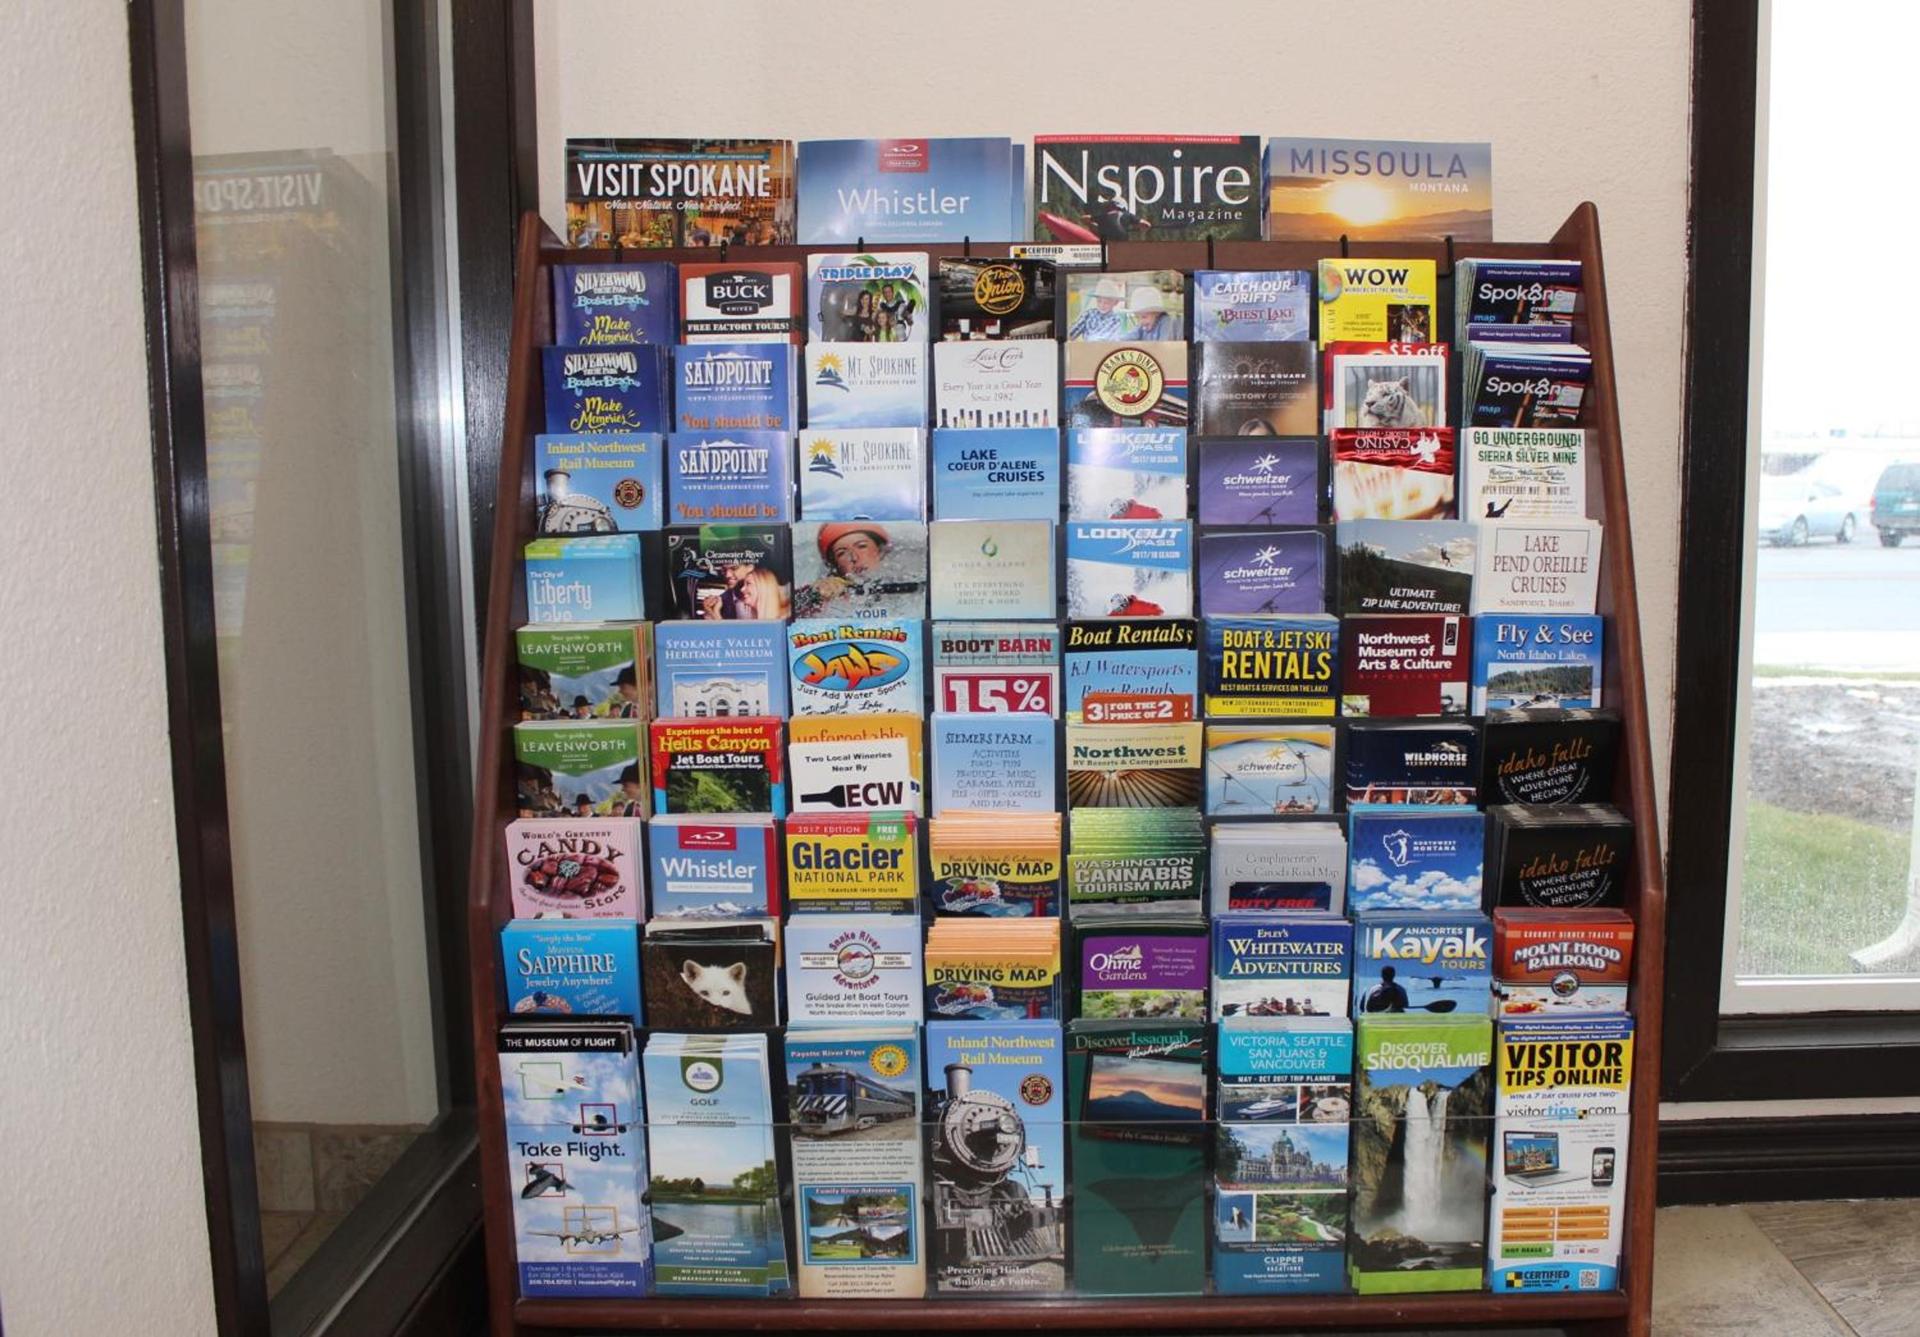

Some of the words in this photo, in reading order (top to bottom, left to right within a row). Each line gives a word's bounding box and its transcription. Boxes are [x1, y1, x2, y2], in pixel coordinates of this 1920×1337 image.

[1291, 147, 1468, 178] MISSOULA
[577, 164, 643, 197] VISIT
[650, 163, 771, 197] SPOKANE
[1039, 149, 1251, 216] Nspire
[1409, 182, 1469, 193] MONTANA
[604, 199, 633, 210] Near
[836, 189, 970, 215] Whistler
[1162, 208, 1243, 224] Magazine
[1344, 268, 1409, 286] WOW
[713, 284, 767, 300] BUCK
[688, 323, 711, 333] FREE
[713, 322, 752, 333] FACTORY
[755, 321, 790, 332] TOURS!
[684, 359, 772, 385] SANDPOINT
[869, 355, 917, 378] SPOKANE
[547, 442, 584, 455] Inland
[587, 441, 646, 454] Northwest
[862, 441, 912, 463] SPOKANE
[961, 449, 998, 461] LAKE
[559, 457, 581, 469] Rail
[584, 457, 635, 469] Museum
[679, 448, 769, 474] SANDPOINT
[1478, 450, 1514, 463] SIERRA
[1515, 450, 1550, 463] SILVER
[1552, 451, 1578, 465] MINE
[947, 462, 985, 472] COEUR
[988, 460, 1037, 471] D'ALENE
[987, 471, 1045, 484] CRUISES
[1223, 473, 1291, 486] schweitzer
[1077, 527, 1183, 540] LOOKOUT
[1523, 535, 1559, 553] LAKE
[705, 549, 744, 560] Clearwater
[744, 549, 765, 560] River
[1492, 555, 1530, 573] PEND
[1533, 556, 1588, 574] OREILLE
[530, 571, 541, 581] The
[542, 571, 555, 581] City
[556, 571, 564, 580] of
[1223, 566, 1292, 579] schweitzer
[1511, 576, 1567, 594] CRUISES
[532, 578, 592, 610] Liberty
[1389, 587, 1437, 600] ULTIMATE
[855, 608, 888, 619] YOUR
[1358, 633, 1430, 644] Northwest
[1496, 623, 1527, 646] Fly
[1534, 625, 1552, 644] &
[1559, 625, 1594, 644] See
[521, 641, 623, 654] LEAVENWORTH
[665, 638, 722, 650] SPOKANE
[725, 637, 772, 649] VALLEY
[941, 639, 995, 654] BOOT
[998, 638, 1051, 652] BARN
[665, 649, 717, 660] HERITAGE
[721, 648, 774, 660] MUSEUM
[1358, 646, 1419, 657] Museum
[1421, 645, 1436, 657] of
[1222, 650, 1332, 680] RENTALS
[1358, 658, 1388, 670] Arts
[1390, 659, 1402, 670] &
[1403, 659, 1452, 670] Culture
[797, 684, 819, 696] Just
[822, 691, 840, 699] Add
[844, 690, 874, 700] Water
[877, 679, 908, 697] Sports
[949, 678, 1046, 713] 15%
[665, 727, 715, 737] Experience
[716, 726, 731, 735] the
[732, 725, 751, 735] best
[753, 726, 764, 735] of
[522, 739, 627, 753] LEAVENWORTH
[659, 736, 704, 752] Hells
[705, 734, 771, 754] Canyon
[805, 755, 824, 763] Two
[826, 754, 852, 762] Local
[853, 751, 893, 761] Wineries
[1073, 744, 1187, 759] Northwest
[1404, 753, 1468, 762] WILDHORSE
[676, 754, 695, 765] Jet
[696, 753, 724, 764] Boat
[725, 753, 761, 764] Tours
[1073, 759, 1086, 767] RV
[1087, 759, 1118, 767] Resorts
[1120, 759, 1127, 767] &
[1129, 757, 1189, 768] Campgrounds
[831, 765, 854, 773] Near
[855, 764, 868, 773] By
[846, 781, 904, 807] ECW
[516, 837, 625, 866] CANDY
[792, 841, 904, 873] Glacier
[660, 857, 757, 879] Whistler
[940, 862, 1012, 877] DRIVING
[1015, 861, 1054, 876] MAP
[1073, 857, 1195, 868] WASHINGTON
[793, 871, 862, 883] NATIONAL
[868, 870, 905, 882] PARK
[1074, 866, 1194, 882] CANNABIS
[1074, 882, 1151, 893] TOURISM
[1154, 879, 1194, 891] MAP
[1404, 927, 1464, 936] ANACORTES
[1558, 931, 1586, 940] DINNER
[1588, 931, 1614, 939] TRAINS
[1228, 938, 1345, 956] WHITEWATER
[1372, 927, 1488, 964] Kayak
[518, 947, 617, 976] SAPPHIRE
[1090, 953, 1142, 972] Ohme
[1228, 957, 1342, 975] ADVENTURES
[1440, 960, 1486, 971] TOURS
[1527, 954, 1606, 970] RAILROAD
[933, 968, 1005, 983] DRIVING
[1009, 967, 1048, 981] MAP
[805, 992, 840, 1001] Guided
[842, 993, 856, 1001] Jet
[858, 992, 881, 1001] Boat
[883, 992, 909, 1001] Tours
[505, 1039, 523, 1048] THE
[525, 1038, 568, 1048] MUSEUM
[570, 1038, 582, 1047] OF
[584, 1037, 616, 1047] FLIGHT
[947, 1035, 992, 1049] Inland
[994, 1035, 1056, 1048] Northwest
[1379, 1042, 1448, 1055] DISCOVER
[791, 1050, 821, 1059] Payette
[822, 1050, 843, 1058] River
[845, 1049, 866, 1058] Flyer
[961, 1053, 984, 1065] Rail
[988, 1052, 1044, 1065] Museum
[1506, 1043, 1623, 1069] VISITOR
[1250, 1058, 1327, 1070] VANCOUVER
[1366, 1052, 1489, 1072] SNOQUALMIE
[1238, 1075, 1253, 1083] MAY
[1273, 1075, 1289, 1083] 2017
[1289, 1075, 1305, 1083] TRIP
[1306, 1075, 1337, 1083] PLANNER
[1505, 1071, 1546, 1086] TIPS
[1553, 1068, 1623, 1086] ONLINE
[516, 1141, 562, 1157] Take
[566, 1141, 626, 1162] Flight.
[815, 1187, 840, 1195] Family
[1524, 1269, 1570, 1280] CERTIFIED
